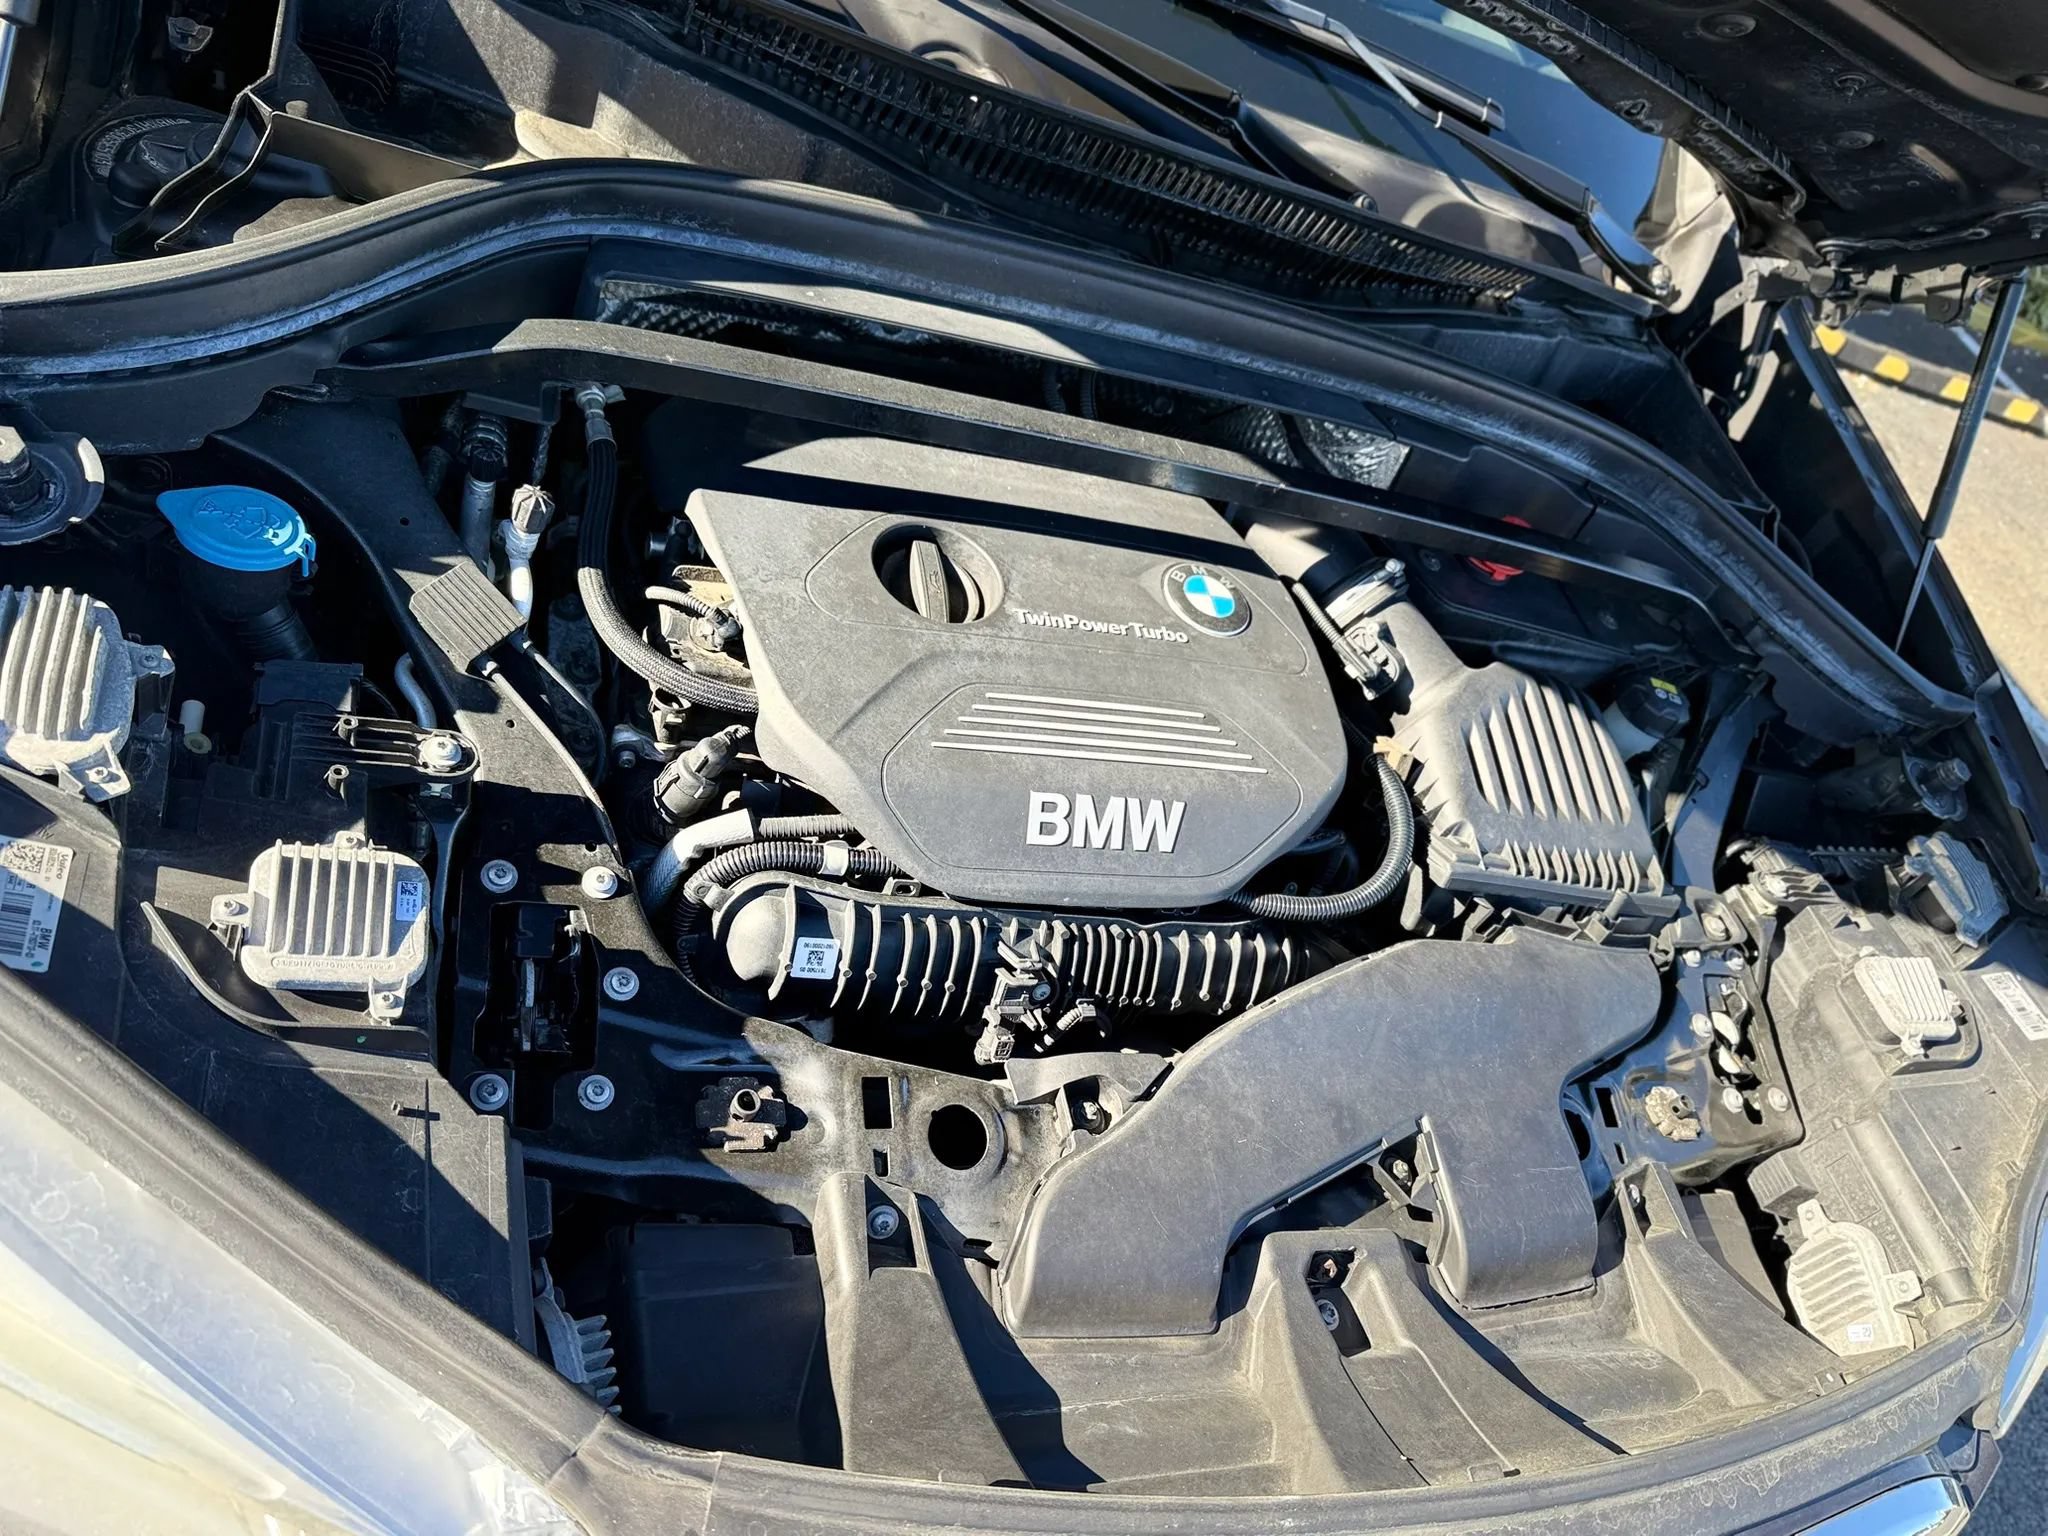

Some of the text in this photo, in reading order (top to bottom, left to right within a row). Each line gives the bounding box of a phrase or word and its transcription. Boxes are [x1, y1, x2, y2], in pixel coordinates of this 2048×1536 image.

[1171, 564, 1236, 590] BMW
[1013, 608, 1190, 643] TwinPowerTurbo
[1026, 790, 1187, 853] BMW
[56, 854, 69, 880] Valeo
[37, 927, 52, 951] BMW
